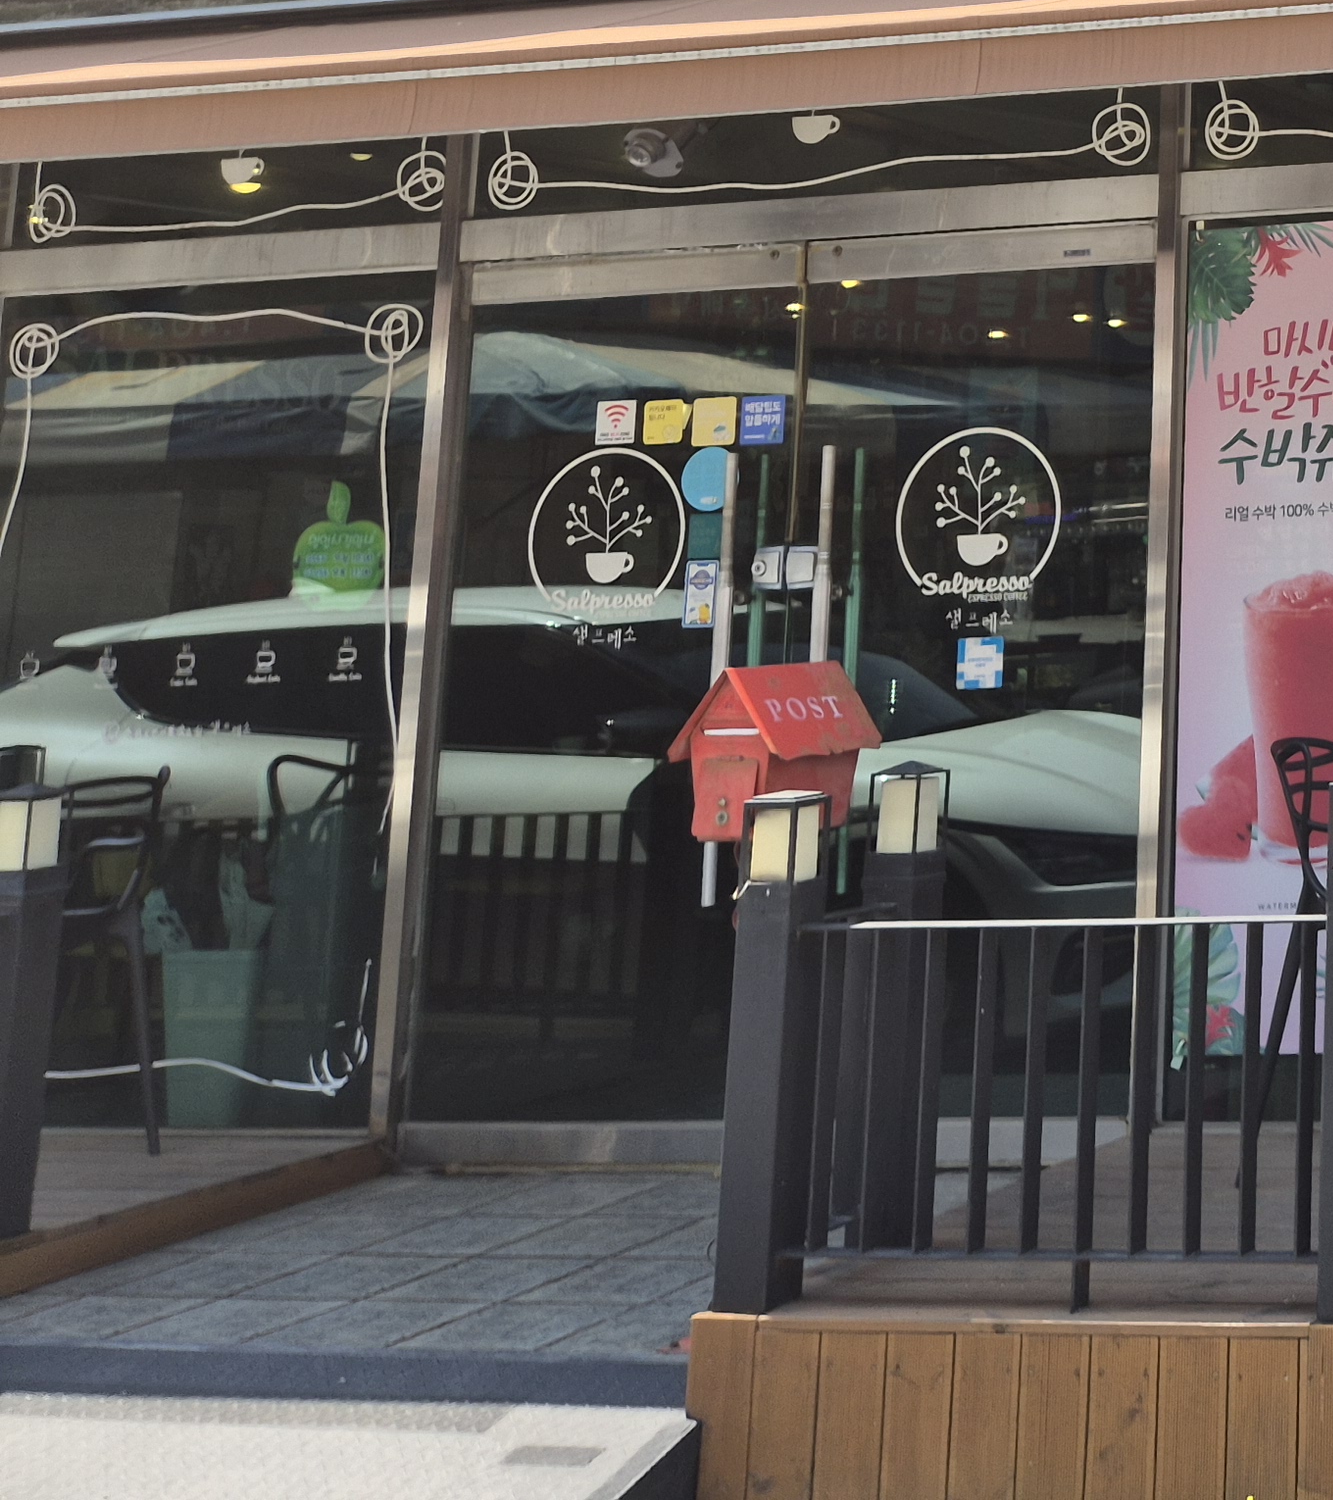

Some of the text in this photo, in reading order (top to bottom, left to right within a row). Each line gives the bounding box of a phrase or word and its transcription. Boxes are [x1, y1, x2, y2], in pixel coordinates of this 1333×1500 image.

[1225, 506, 1249, 522] 리얼
[1252, 505, 1276, 520] 수박
[1280, 504, 1314, 518] 100%
[921, 572, 1034, 599] Salpresso
[551, 589, 655, 615] Salpresso
[764, 696, 843, 723] POST
